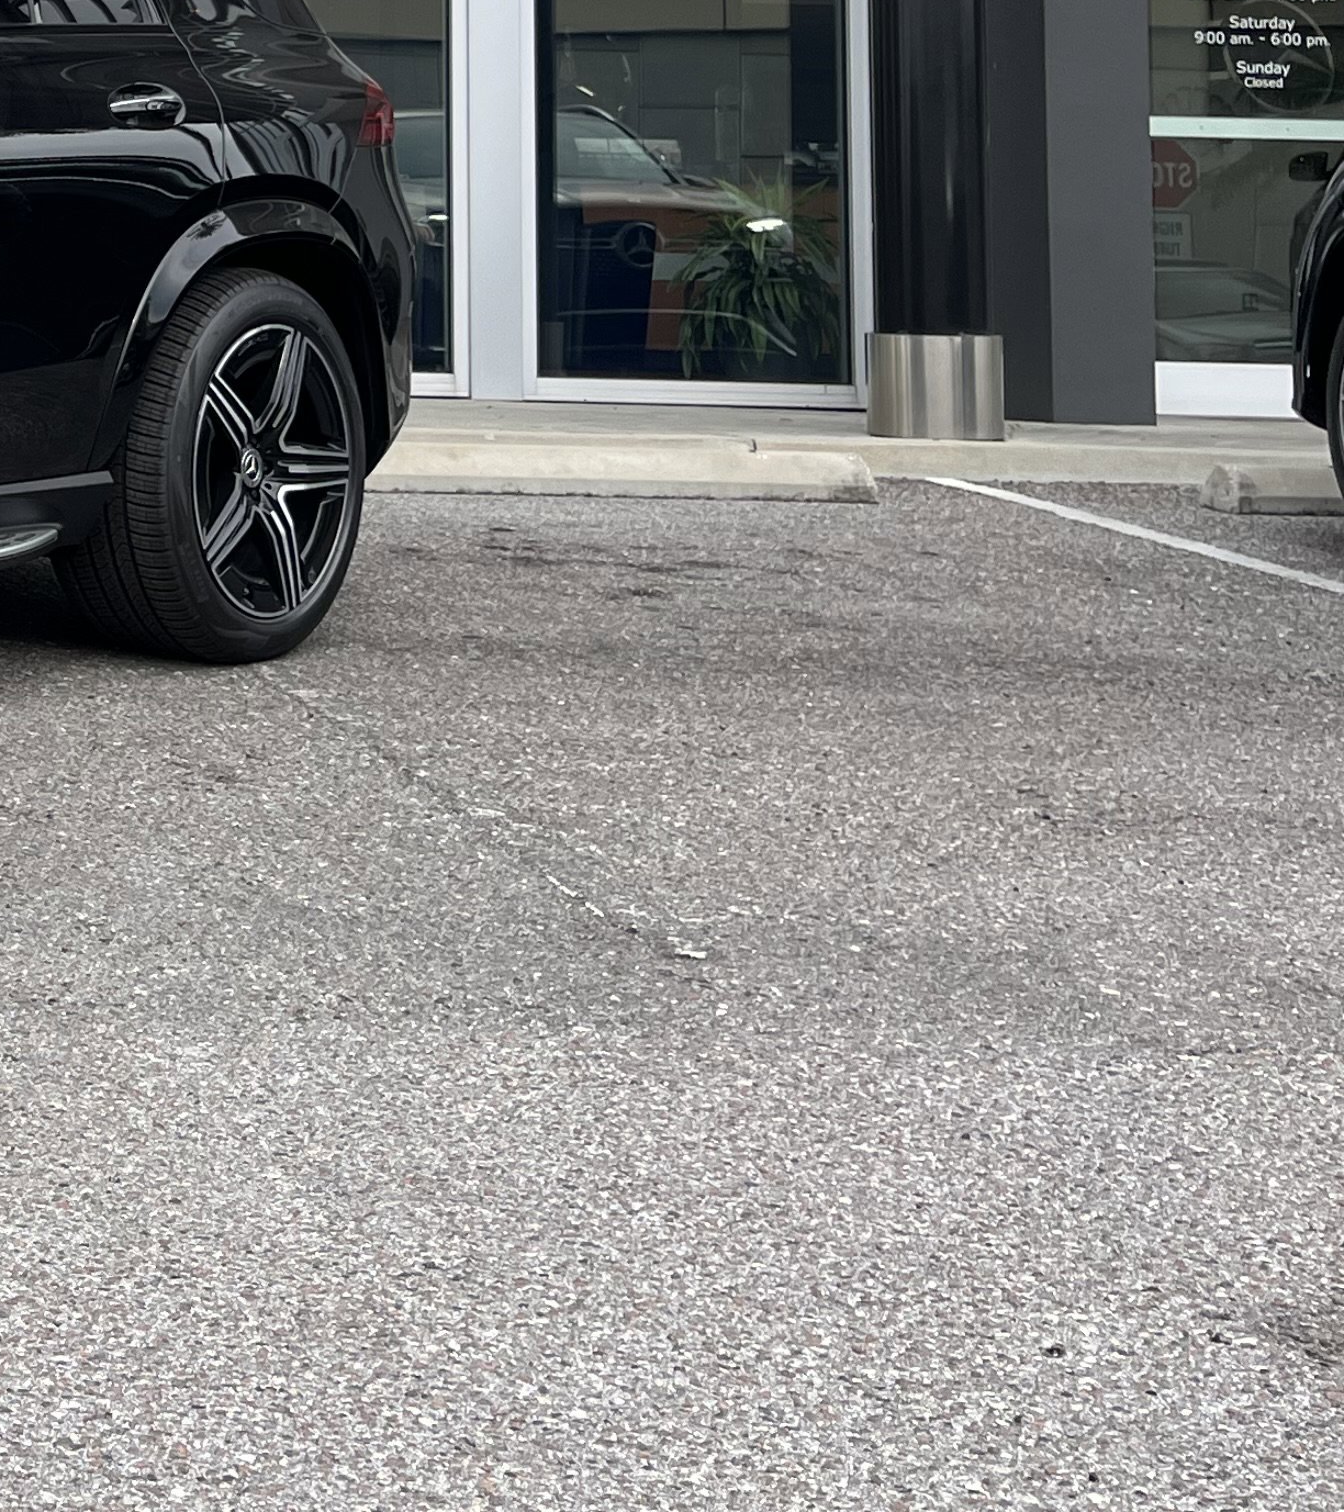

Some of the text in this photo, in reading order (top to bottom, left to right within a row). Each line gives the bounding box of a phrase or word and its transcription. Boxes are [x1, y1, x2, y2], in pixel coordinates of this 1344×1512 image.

[1228, 14, 1296, 32] Saturday
[1193, 30, 1226, 45] 9:00
[1229, 33, 1254, 45] am.
[1270, 32, 1302, 46] 6:00
[1235, 60, 1291, 77] Sunday
[1243, 76, 1285, 88] Closed
